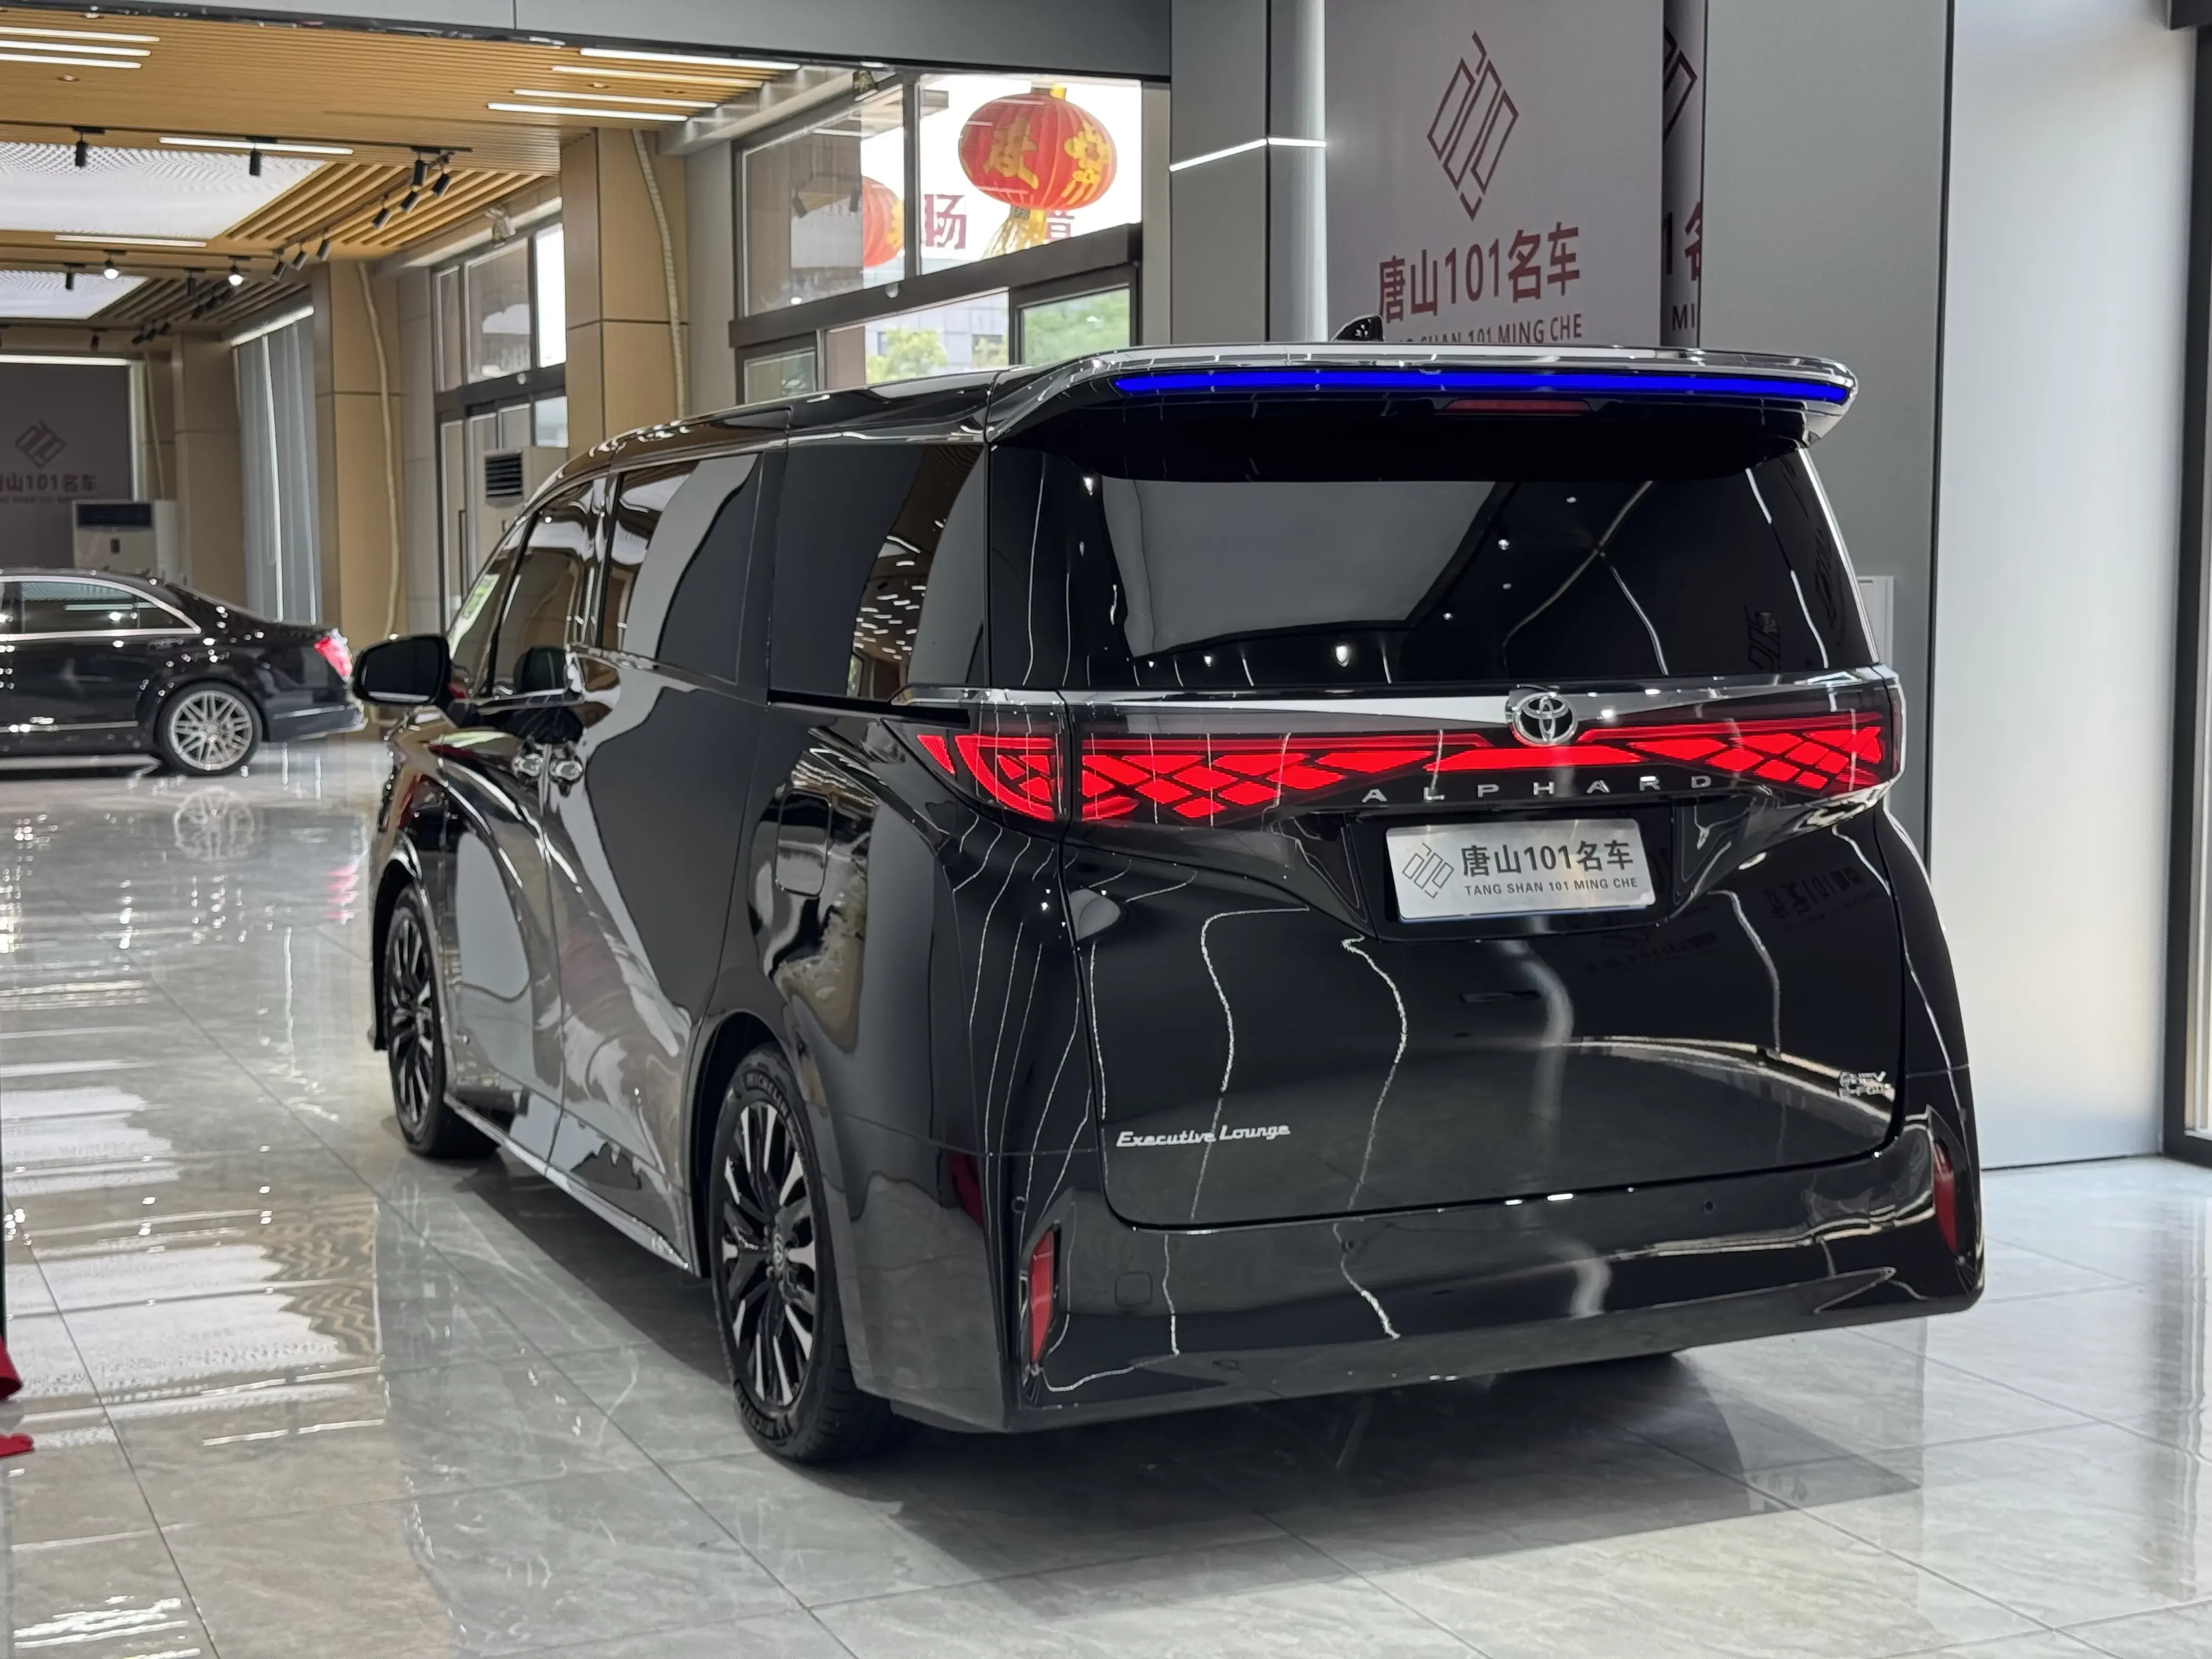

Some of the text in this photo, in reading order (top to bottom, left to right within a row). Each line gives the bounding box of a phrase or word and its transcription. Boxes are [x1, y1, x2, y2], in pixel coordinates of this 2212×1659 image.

[1379, 222, 1580, 324] 唐山101名车
[1498, 319, 1544, 344] MING
[1550, 313, 1583, 342] CHE
[1362, 775, 1712, 804] ALPHARD
[1460, 839, 1634, 878] 唐山101名车
[1464, 877, 1639, 896] TANG SHAN 101 MING CHE
[1116, 1124, 1291, 1147] Executive Lounge
